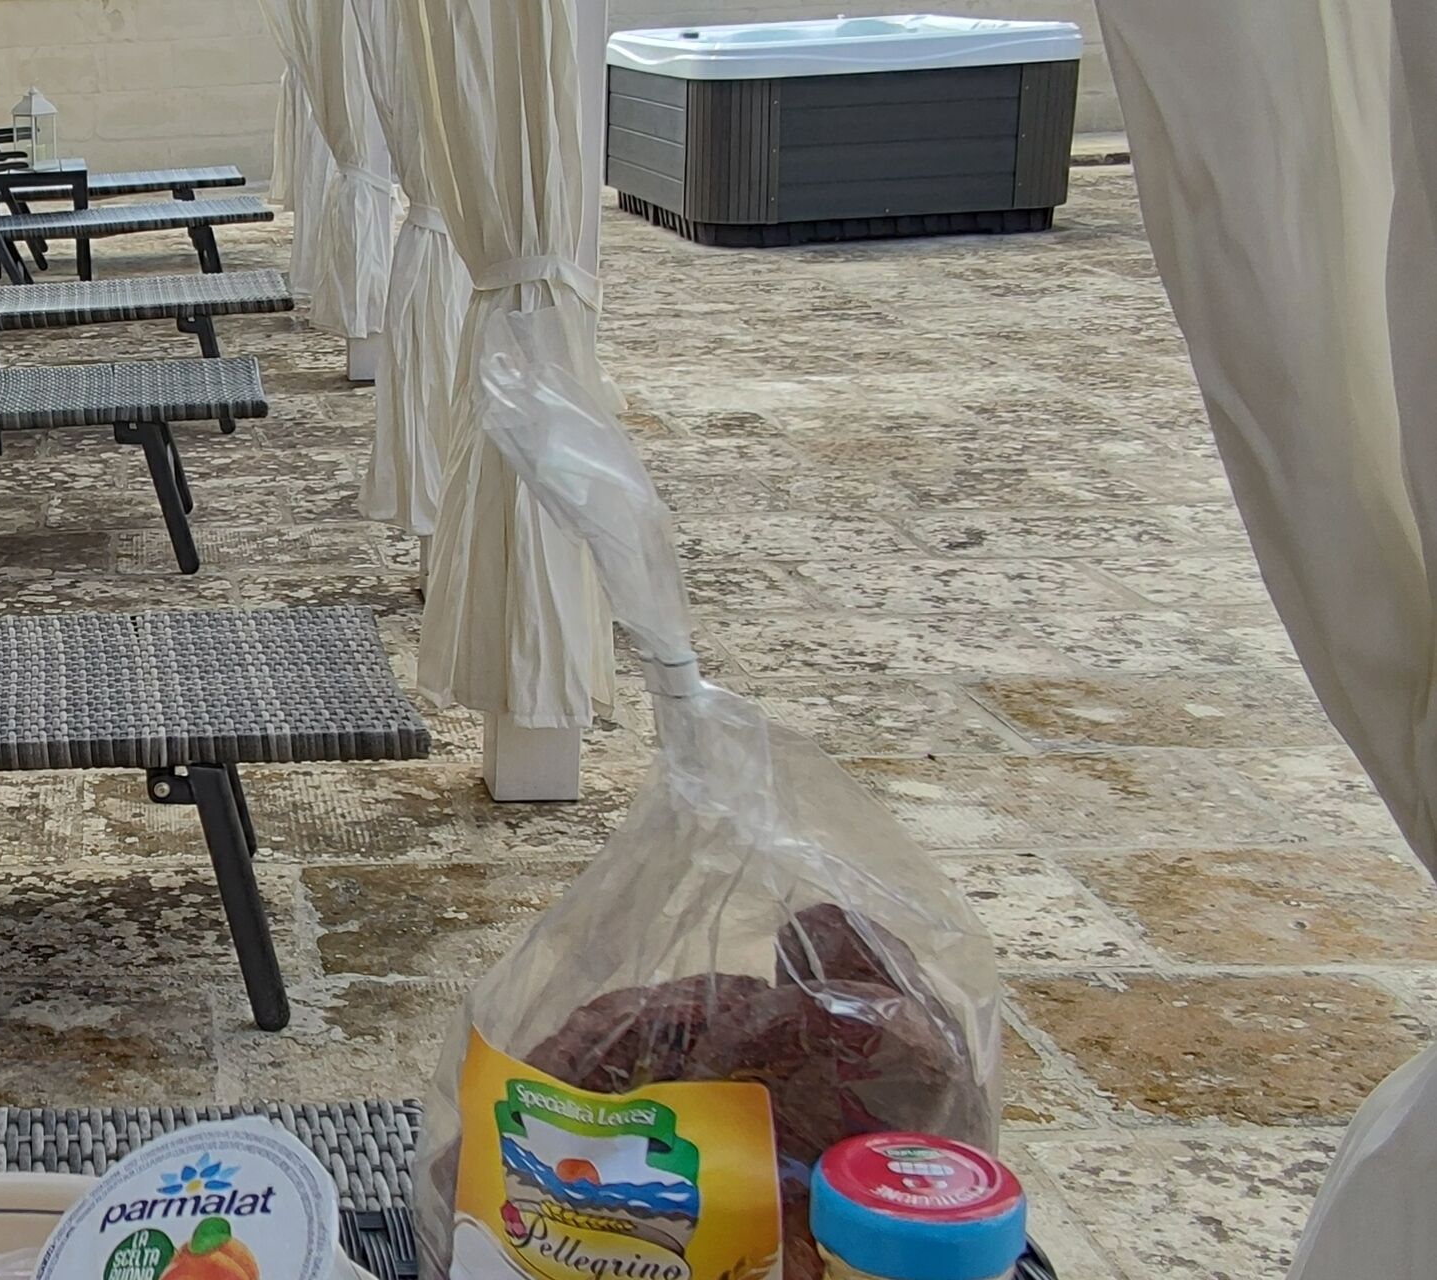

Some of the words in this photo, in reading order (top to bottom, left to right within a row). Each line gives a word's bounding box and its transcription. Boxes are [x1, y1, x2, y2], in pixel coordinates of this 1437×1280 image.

[515, 1084, 594, 1124] Specialità
[100, 1186, 276, 1234] parmalat
[132, 1230, 148, 1249] LA
[113, 1249, 160, 1268] SCELTA
